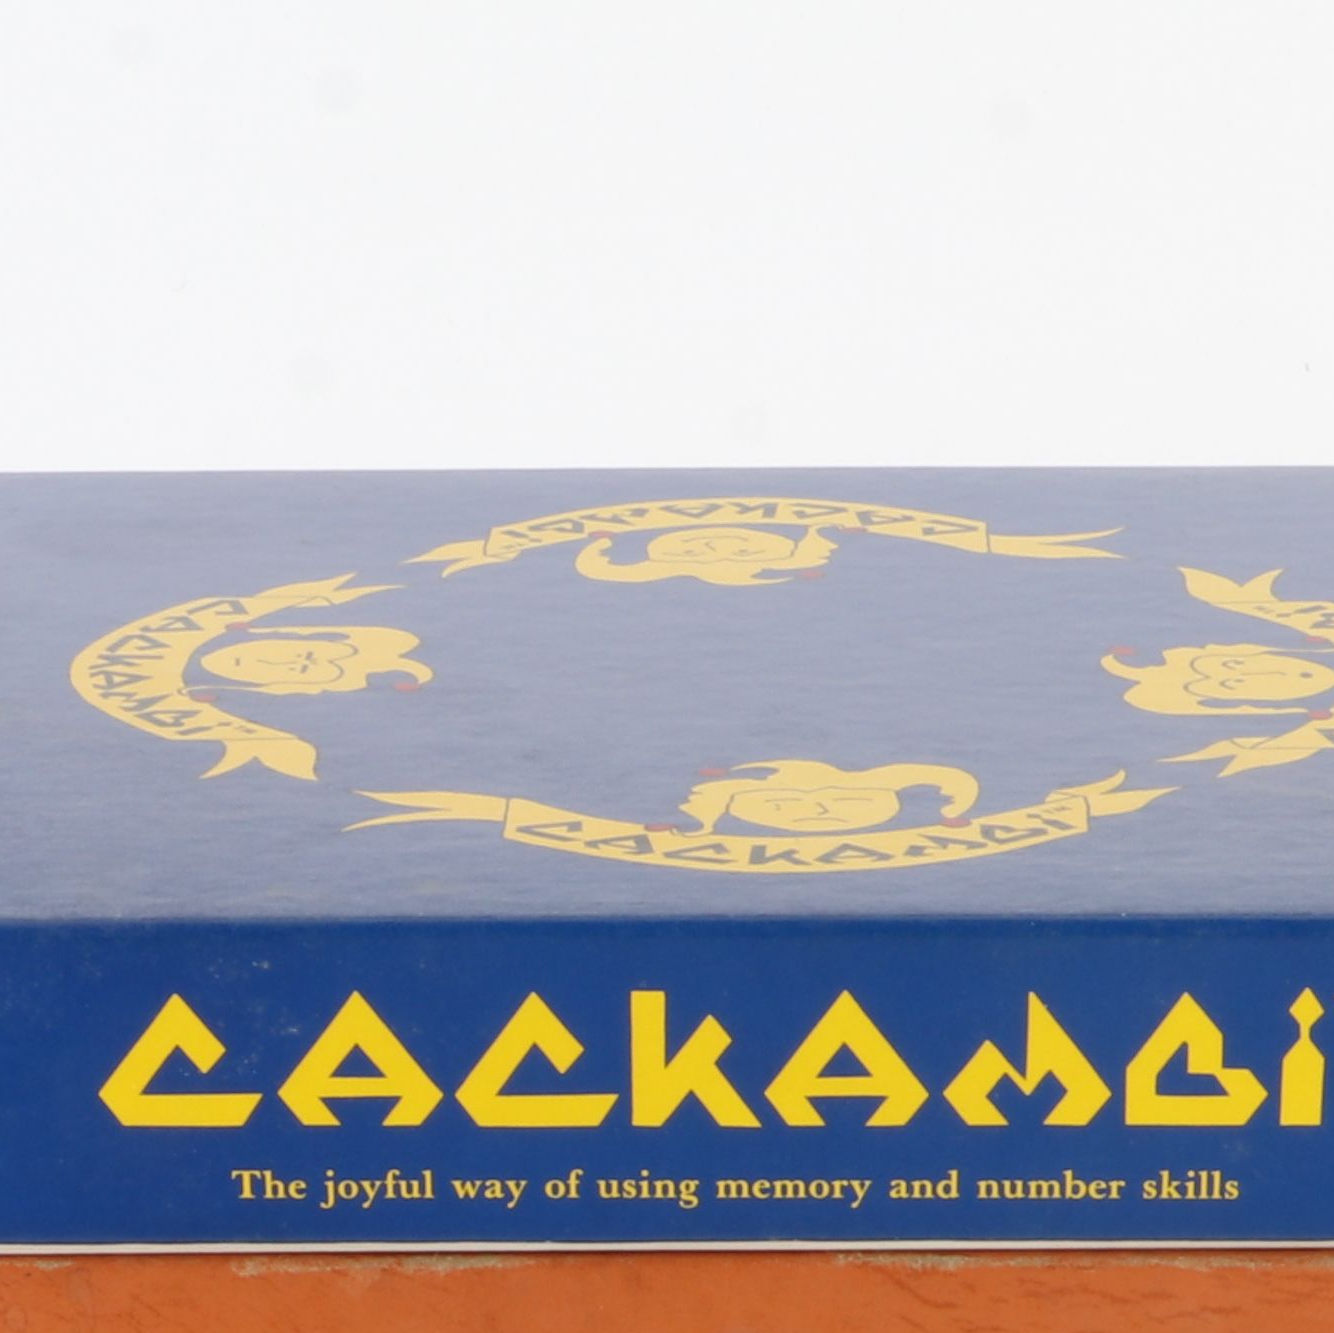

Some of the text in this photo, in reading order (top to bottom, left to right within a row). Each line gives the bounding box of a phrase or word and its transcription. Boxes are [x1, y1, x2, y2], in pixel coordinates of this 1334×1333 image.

[231, 1169, 1240, 1208] The joyful way of using memory and number skills
